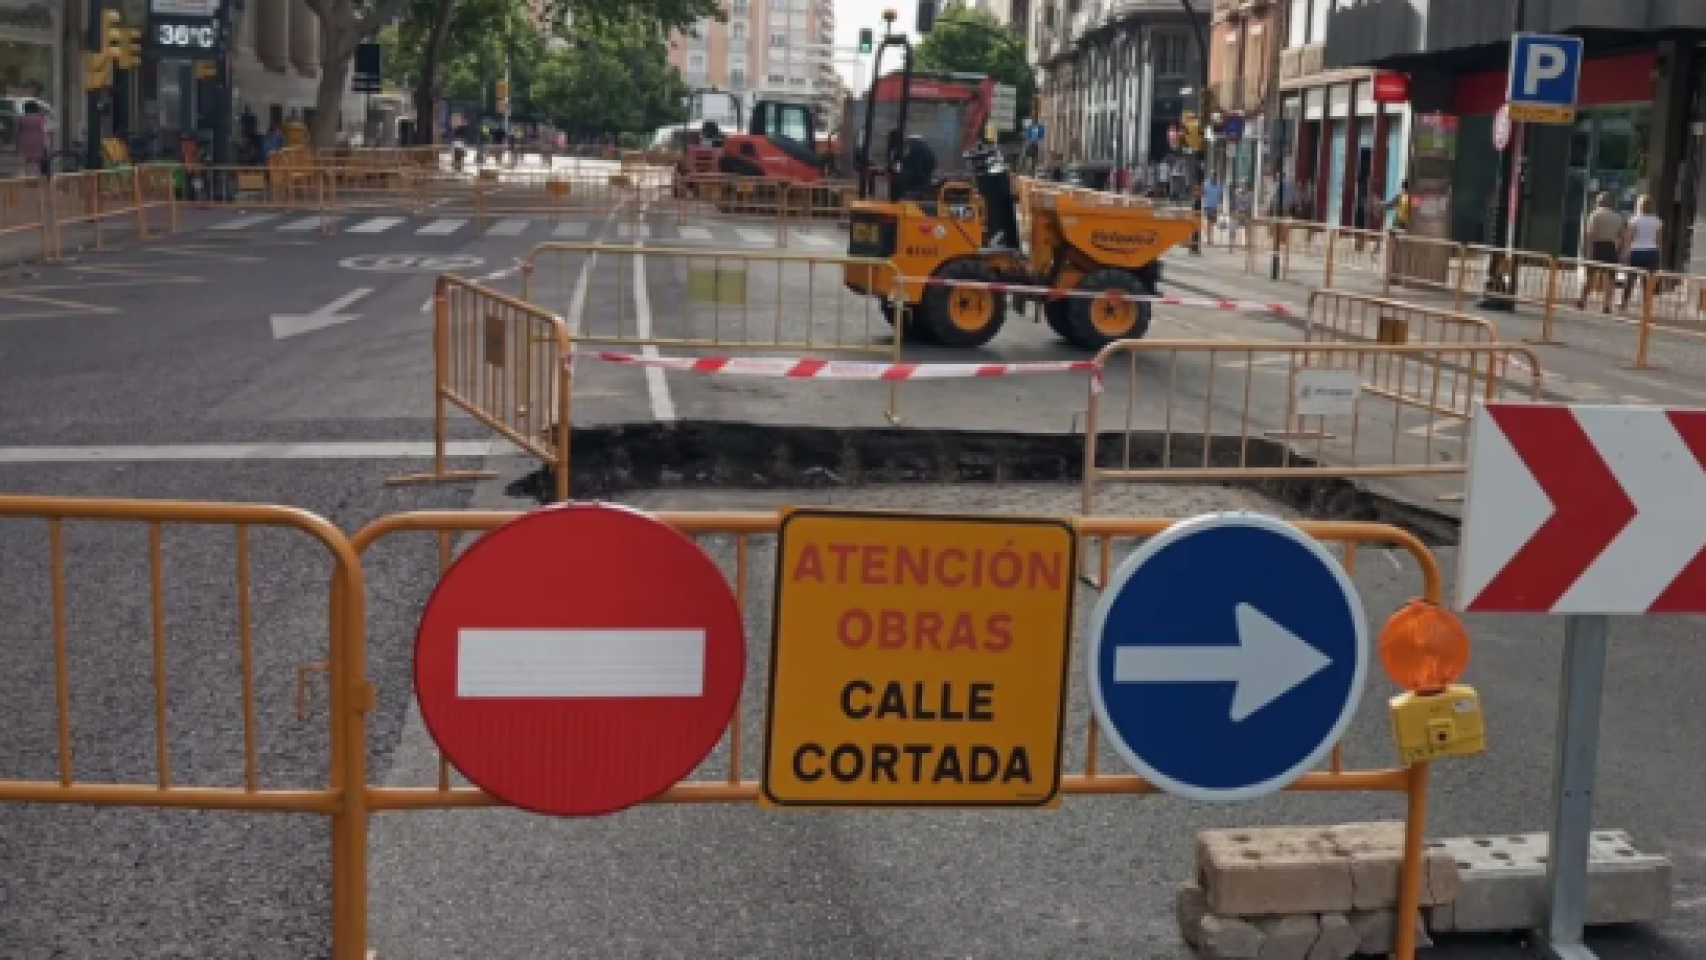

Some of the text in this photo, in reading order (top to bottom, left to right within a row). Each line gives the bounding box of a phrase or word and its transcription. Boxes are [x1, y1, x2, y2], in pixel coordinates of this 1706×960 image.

[1524, 43, 1566, 95] P
[793, 539, 1062, 591] ATENCIÓN
[837, 608, 1013, 653] OBRAS
[840, 679, 995, 722] CALLE
[792, 742, 1033, 784] CORTADA
